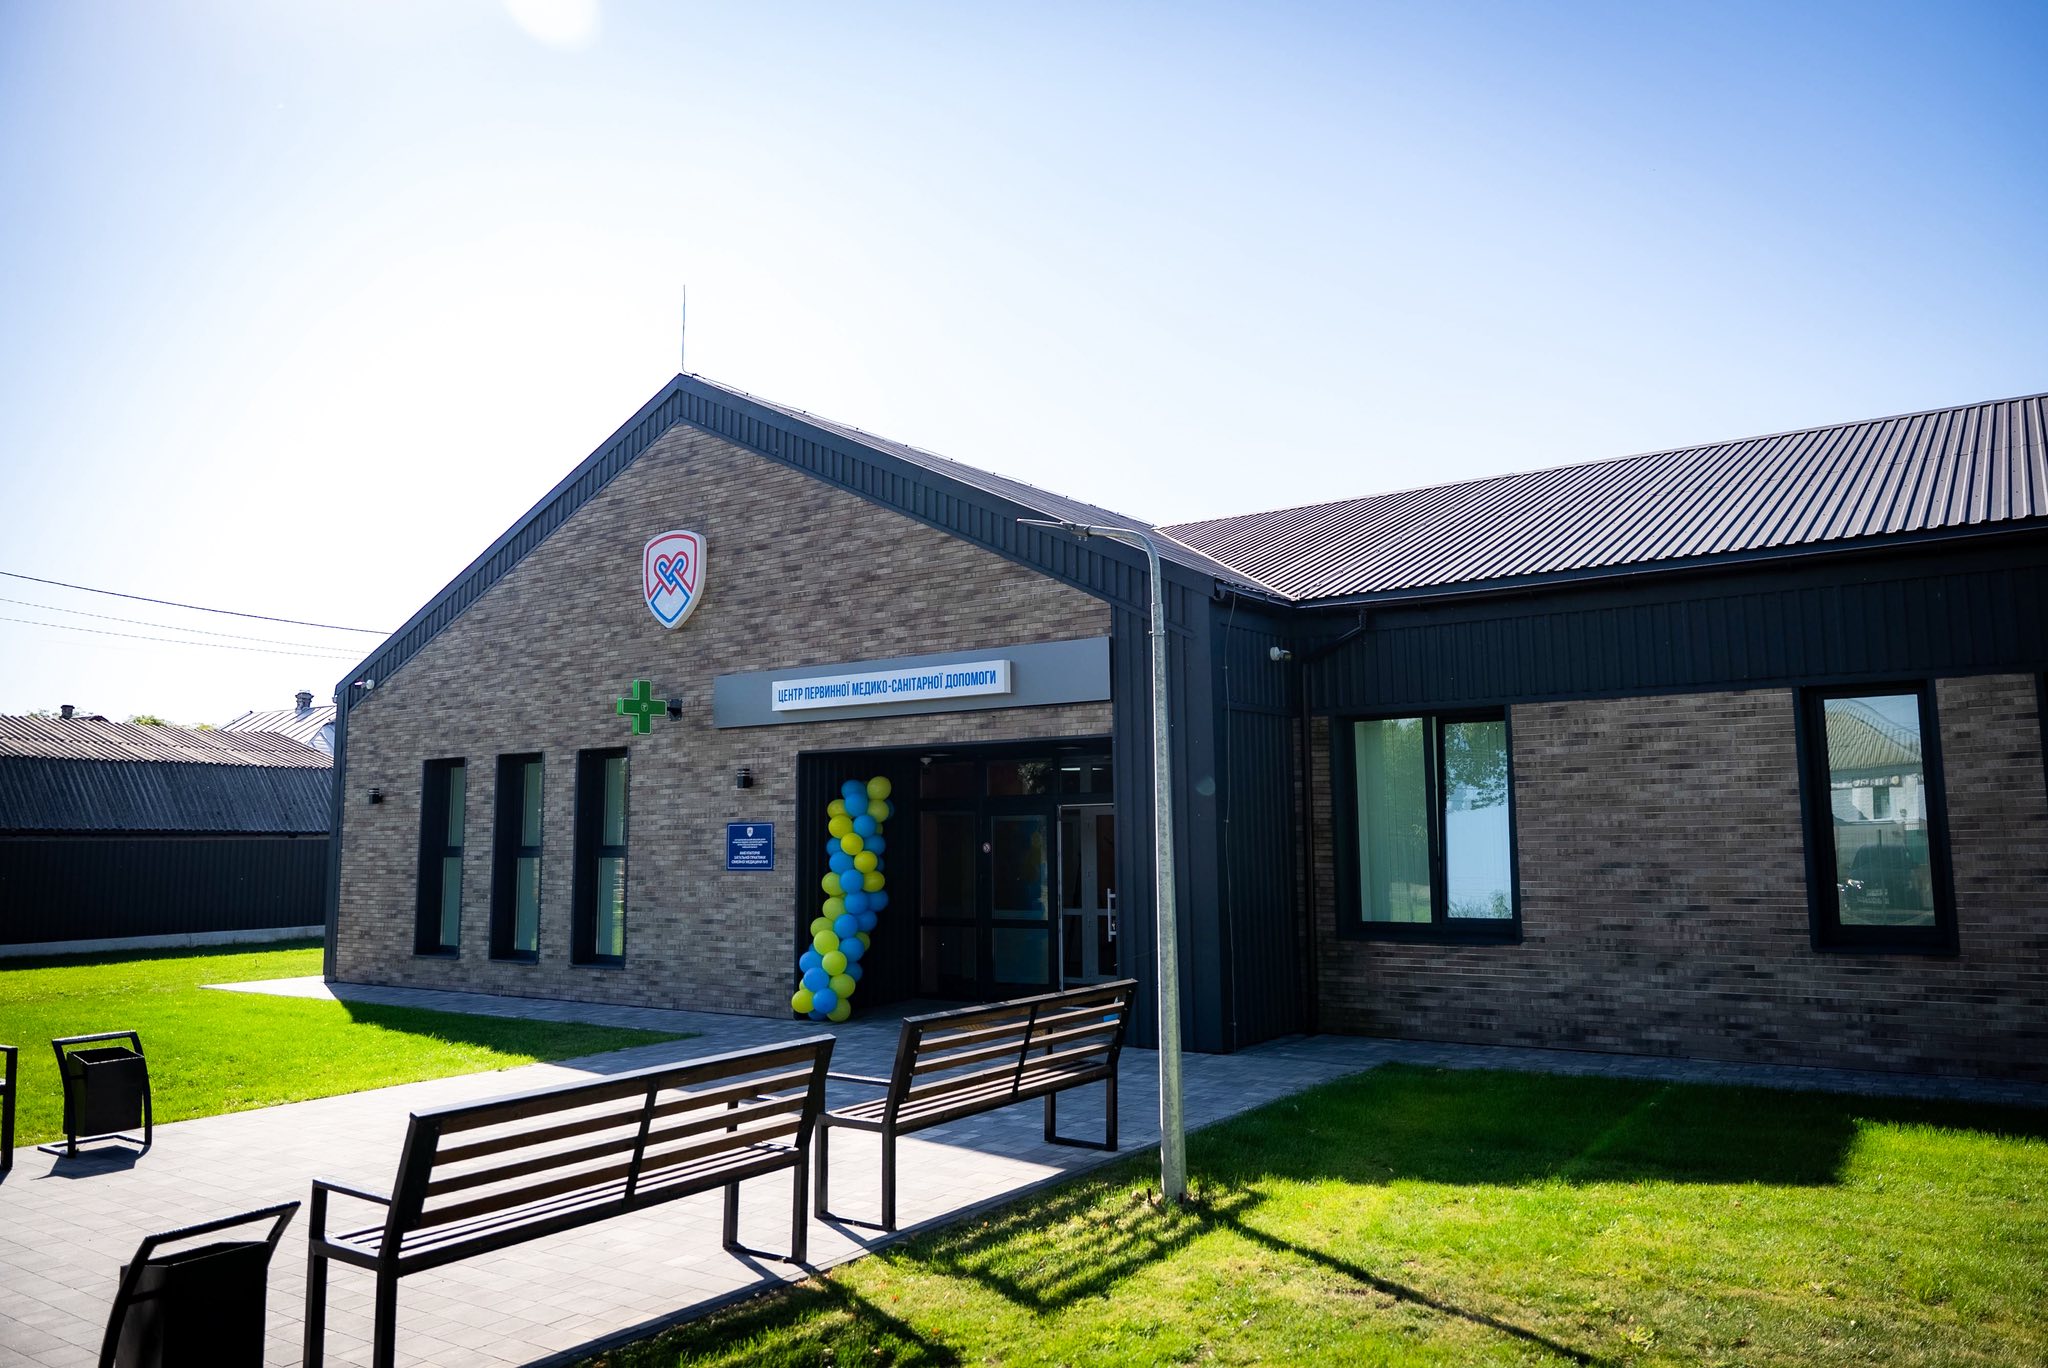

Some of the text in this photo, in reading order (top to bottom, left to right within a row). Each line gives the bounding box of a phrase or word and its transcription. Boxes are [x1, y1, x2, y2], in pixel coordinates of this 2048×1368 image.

[778, 670, 996, 703] ЦЕНТР ПЕРВИННОЇ МЕДИКО-САНІТАРНОЇ ДОПОМОГИ
